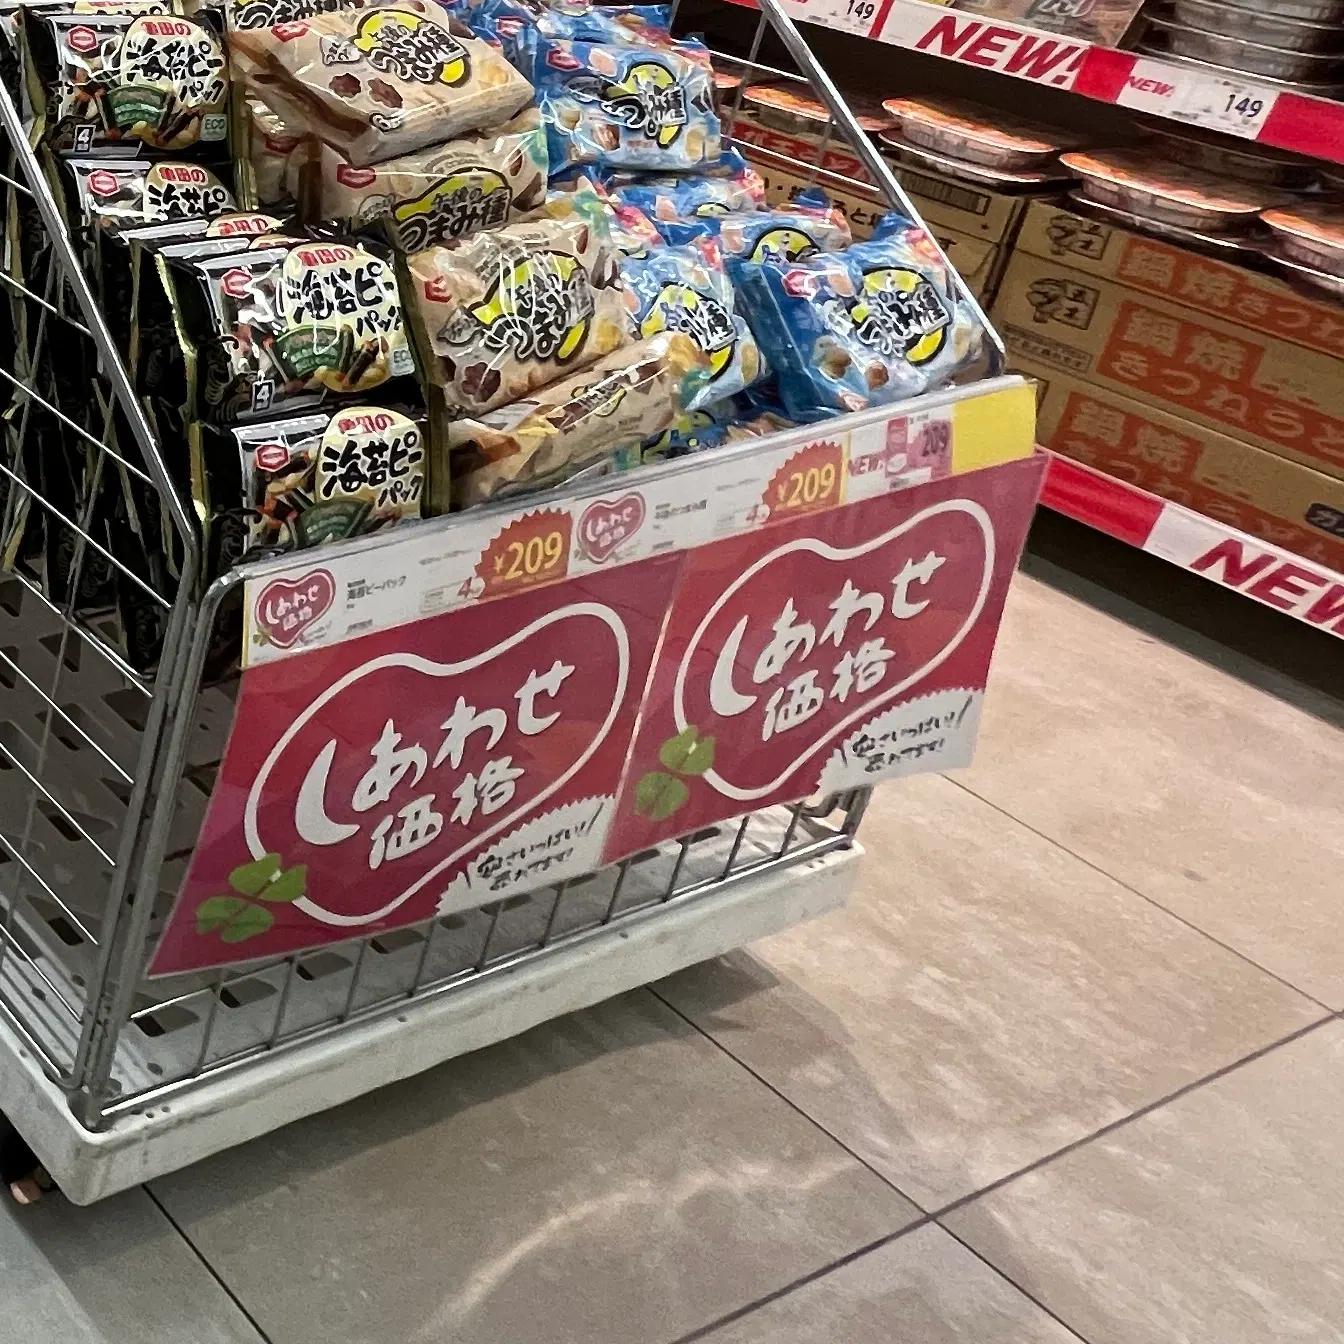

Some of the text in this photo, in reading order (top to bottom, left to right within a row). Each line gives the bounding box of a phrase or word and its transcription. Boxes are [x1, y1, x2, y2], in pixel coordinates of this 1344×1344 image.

[846, 0, 874, 19] 149
[916, 15, 1087, 85] NEW!
[1223, 92, 1263, 118] 149
[399, 190, 510, 248] つまみ種
[377, 474, 424, 508] パック
[1192, 539, 1344, 636] NE
[710, 550, 948, 716] しあわせ
[762, 637, 896, 745] 価格
[297, 660, 575, 847] しあわせ
[368, 756, 525, 872] 価格
